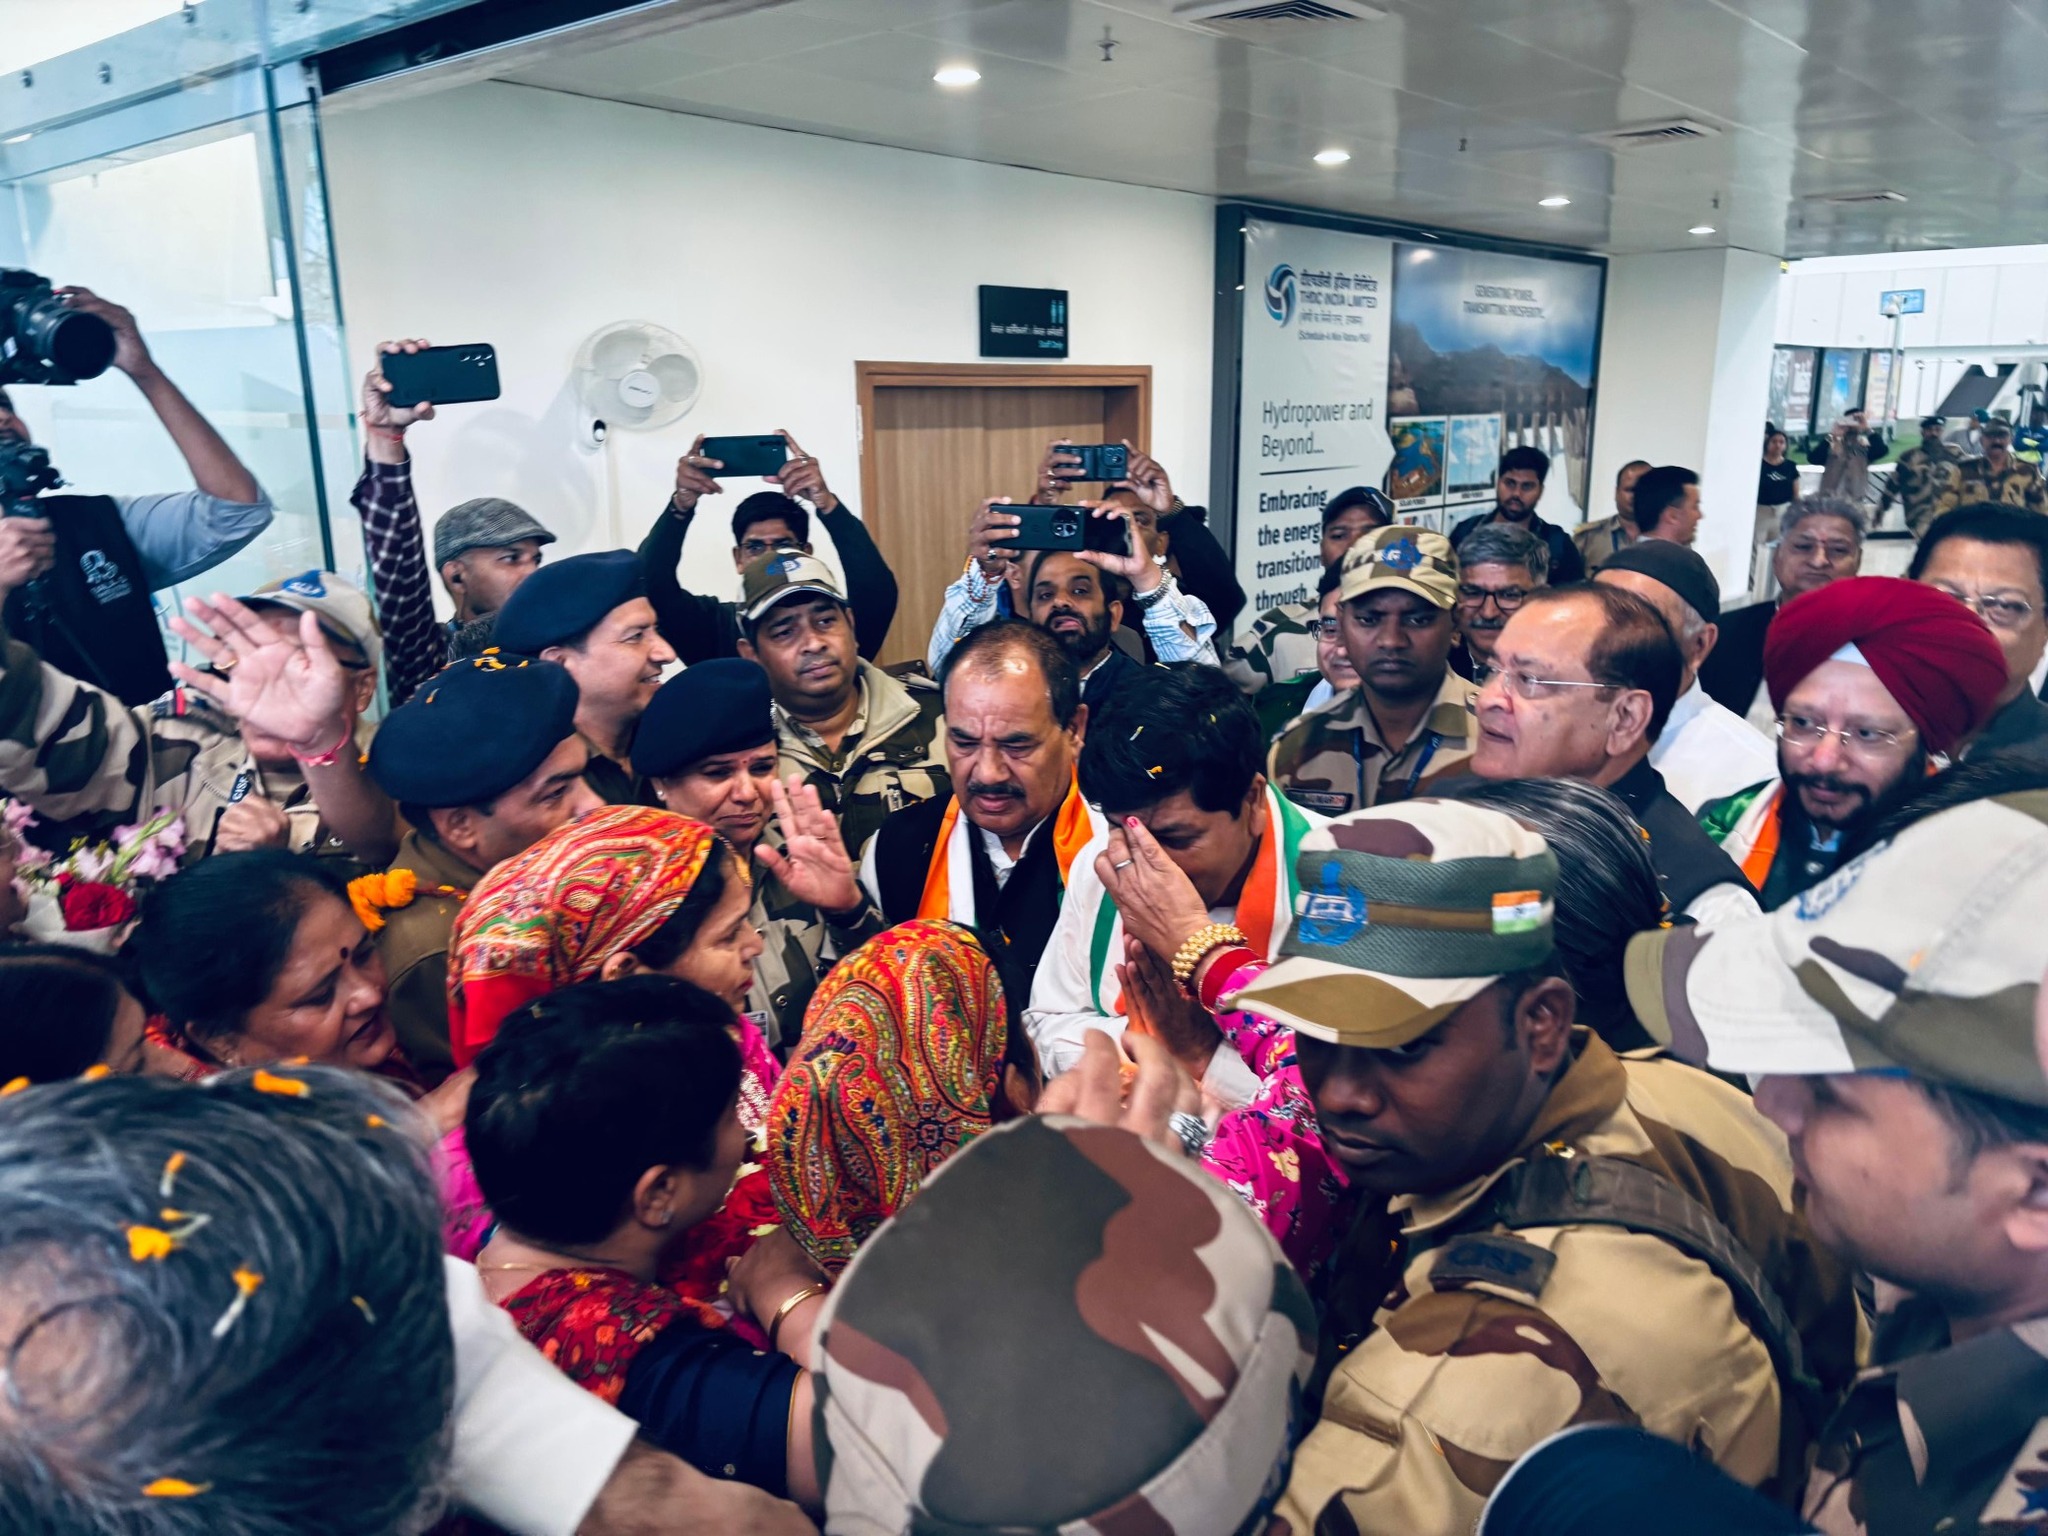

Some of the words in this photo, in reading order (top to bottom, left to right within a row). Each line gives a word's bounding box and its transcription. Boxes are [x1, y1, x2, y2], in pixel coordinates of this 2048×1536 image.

[1299, 290, 1322, 305] THDC
[1324, 292, 1346, 306] INDIA
[1347, 294, 1378, 308] LIMITED
[1262, 398, 1347, 429] Hydropower
[1348, 397, 1374, 421] and
[1259, 485, 1328, 513] Embracing
[1257, 524, 1281, 547] the
[1283, 522, 1321, 545] energ
[1256, 550, 1322, 579] transition
[1255, 583, 1308, 612] through
